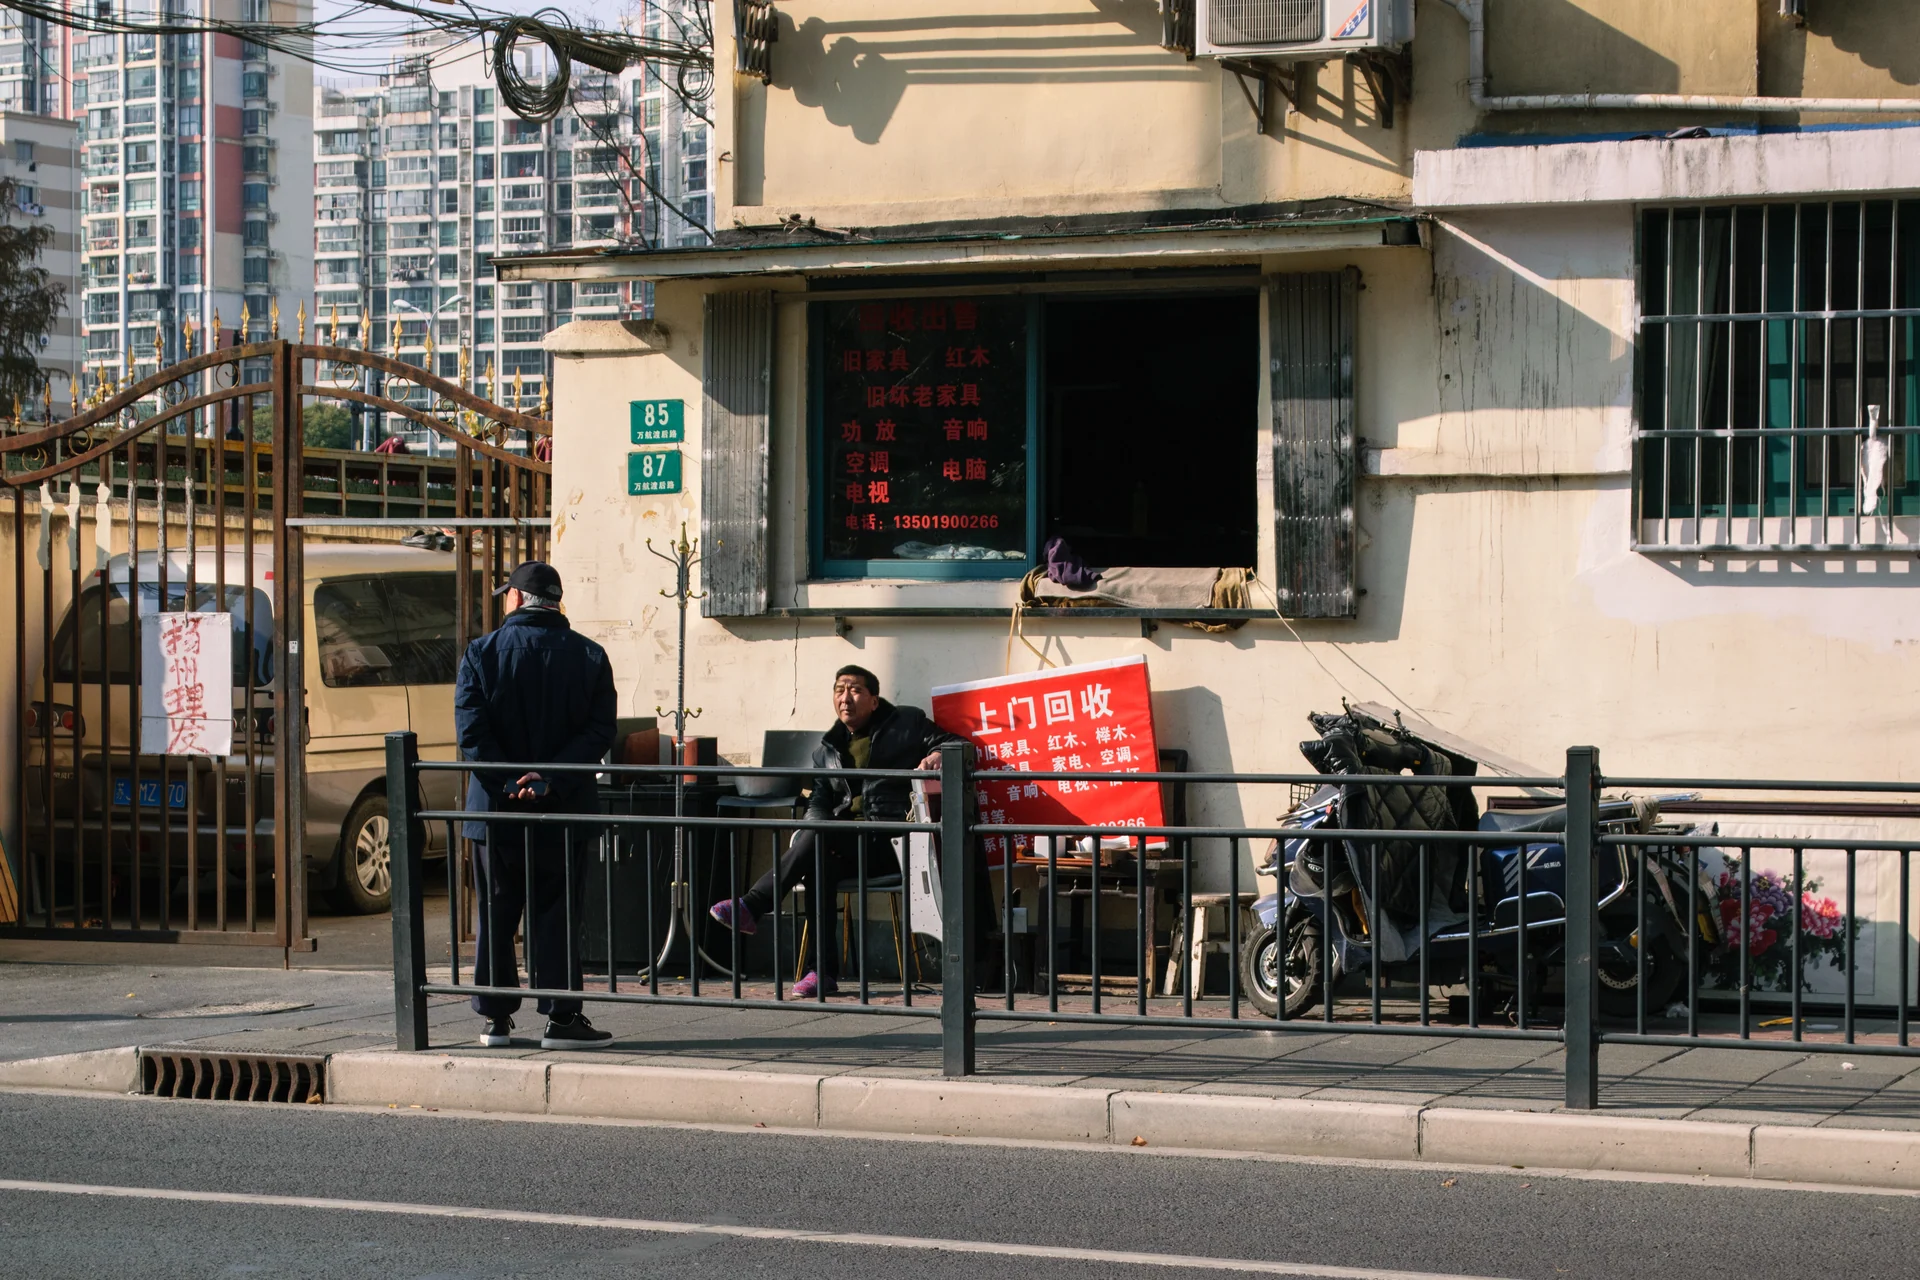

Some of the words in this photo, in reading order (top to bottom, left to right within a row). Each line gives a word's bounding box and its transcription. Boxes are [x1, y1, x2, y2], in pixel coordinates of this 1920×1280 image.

[844, 348, 910, 372] 旧家具
[945, 345, 990, 368] 红木
[644, 403, 669, 427] 85
[637, 429, 677, 440] 万航渡后路
[943, 417, 989, 441] 音响
[642, 453, 666, 478] 87
[846, 451, 890, 473] 空调
[943, 458, 987, 481] 电脑
[634, 480, 675, 491] 万航渡后路
[846, 481, 890, 504] 电视
[893, 514, 999, 529] 13501900266
[162, 617, 210, 754] 扬州理发
[972, 683, 1114, 737] 上门回收
